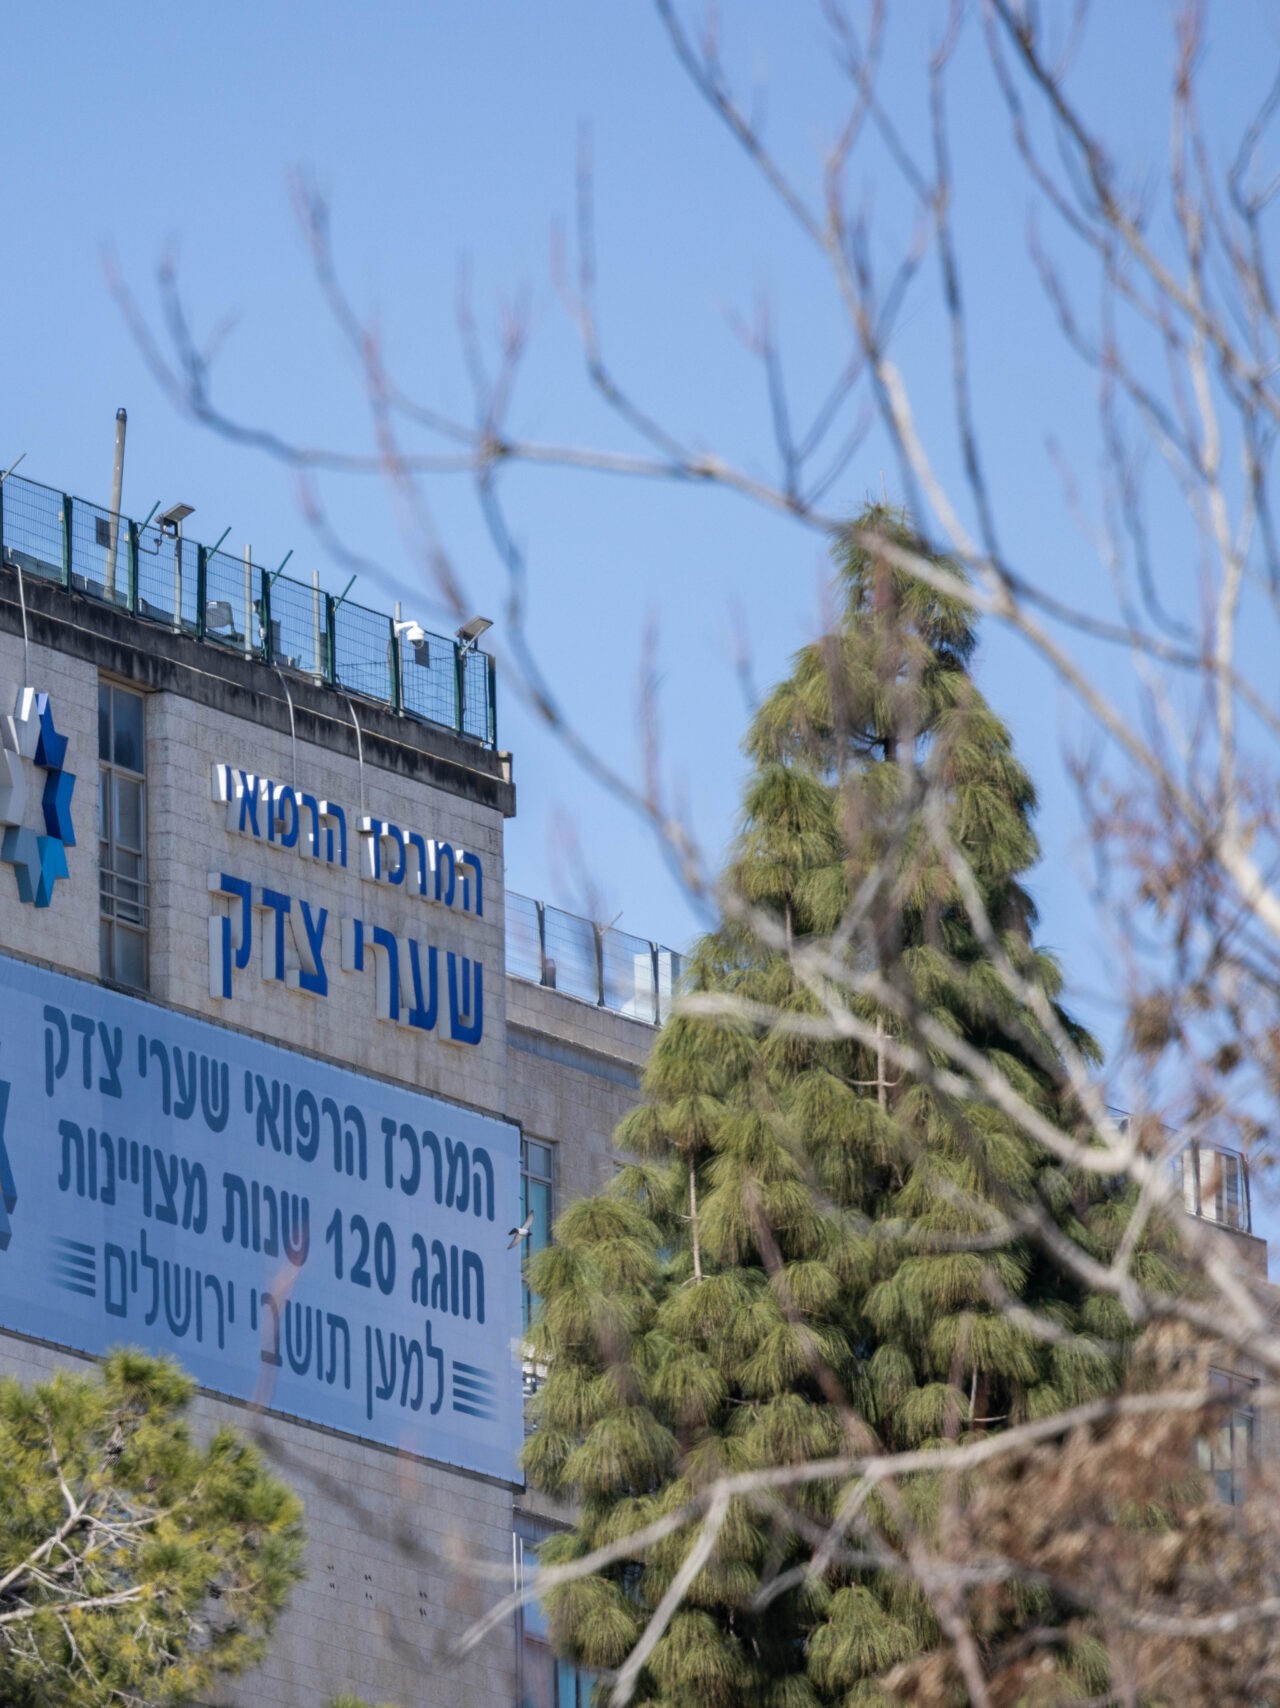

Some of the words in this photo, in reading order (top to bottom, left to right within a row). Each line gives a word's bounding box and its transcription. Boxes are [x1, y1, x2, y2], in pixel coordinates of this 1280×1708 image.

[214, 763, 347, 868] הרפואי
[360, 816, 483, 918] המרכז
[209, 872, 328, 1000] צדק
[344, 917, 483, 1046] שערי
[42, 1004, 123, 1099] צדק
[138, 1034, 230, 1133] שערי
[57, 1118, 208, 1235] מצויינות
[244, 1070, 368, 1181] הרפואי
[380, 1116, 495, 1222] המרכז
[222, 1172, 310, 1267] שנות
[325, 1207, 396, 1296] 120
[104, 1228, 235, 1350] ירושלים
[411, 1233, 485, 1325] חוגג
[250, 1287, 351, 1390] תושבי
[365, 1319, 445, 1420] למען
